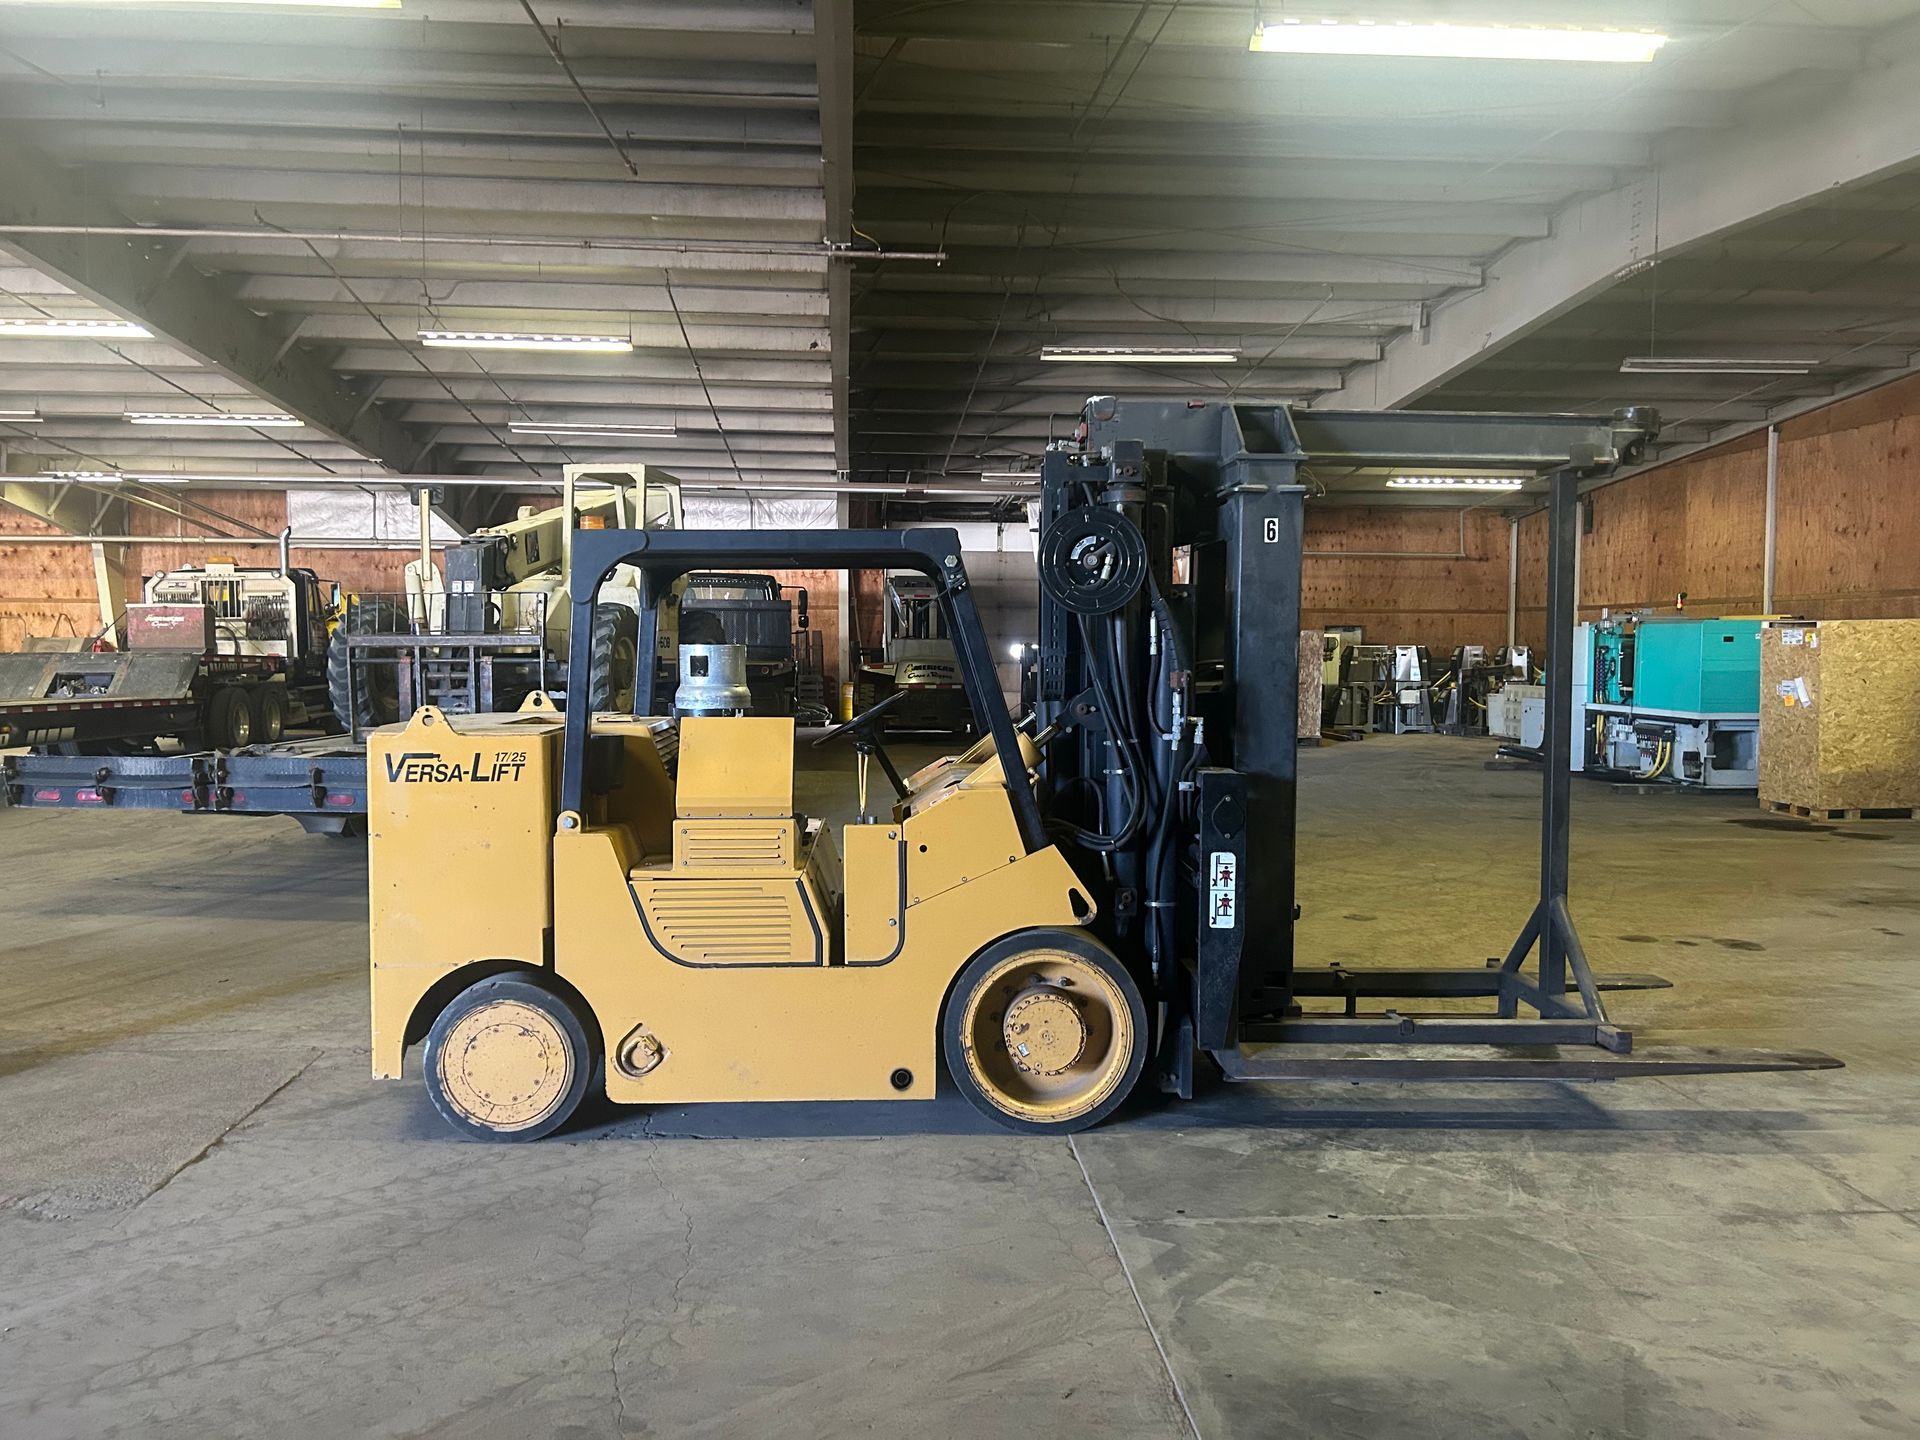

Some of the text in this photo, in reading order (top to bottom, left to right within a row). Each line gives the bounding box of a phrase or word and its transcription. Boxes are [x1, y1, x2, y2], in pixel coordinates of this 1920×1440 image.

[1267, 519, 1276, 541] 6
[385, 753, 525, 783] VERSA-LIFT
[495, 752, 526, 763] 17/25
